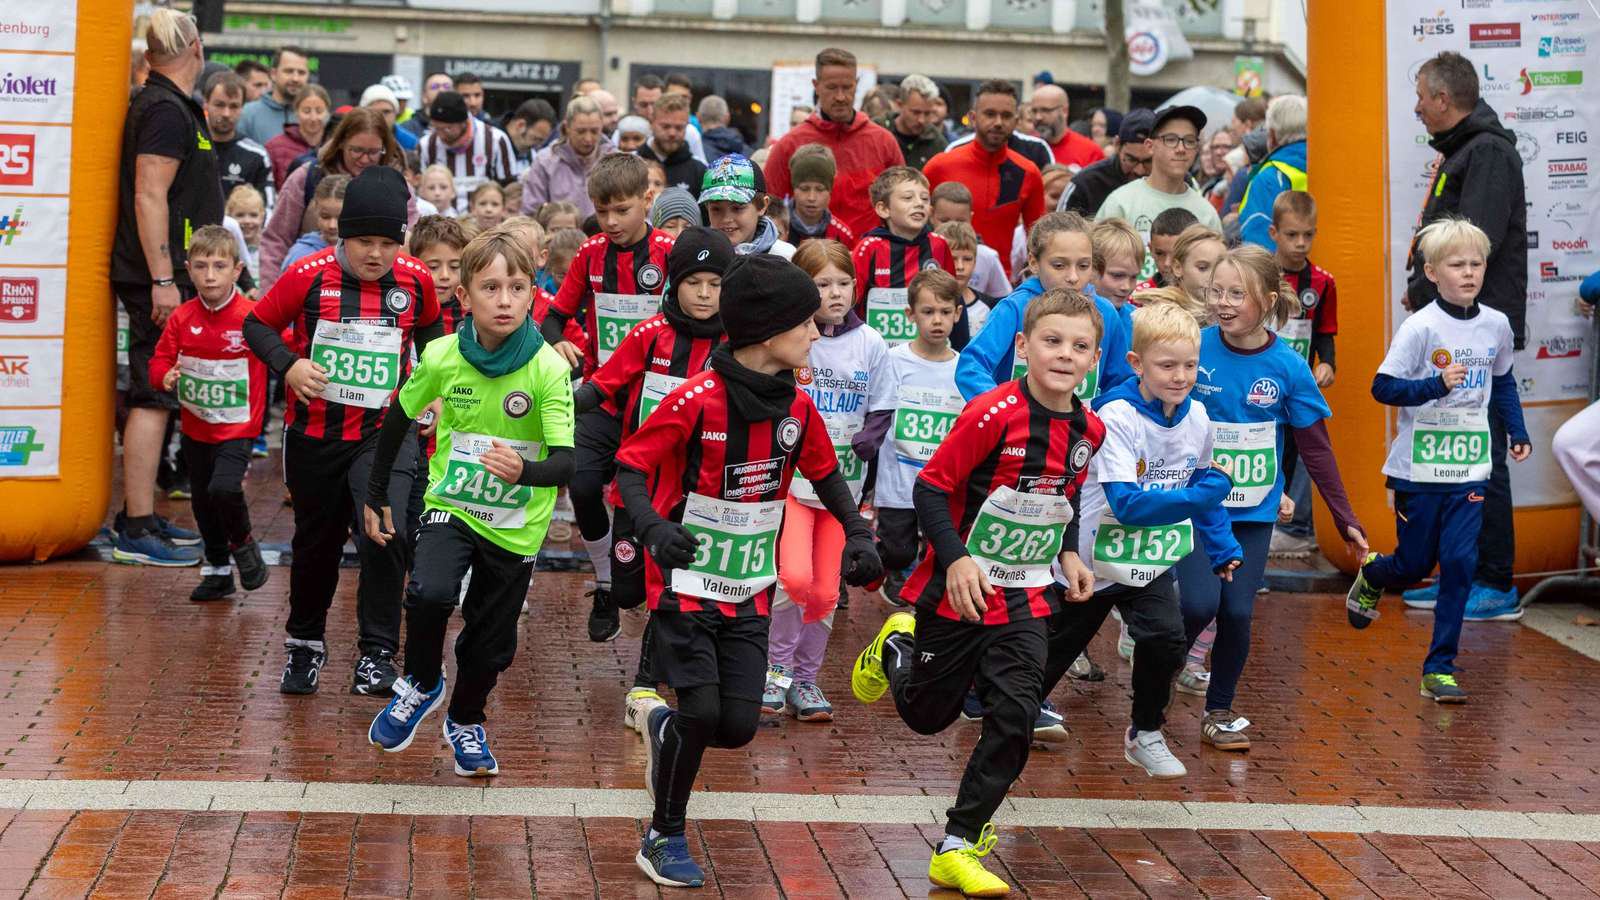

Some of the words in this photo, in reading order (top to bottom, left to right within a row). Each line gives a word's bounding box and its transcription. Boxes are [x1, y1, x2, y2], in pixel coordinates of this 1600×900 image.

[543, 64, 561, 80] 17
[1556, 131, 1588, 144] FEIG
[1547, 162, 1588, 173] STRABAG
[2, 282, 35, 296] RHÖN
[320, 289, 341, 297] JAKO
[876, 312, 918, 337] 335
[1455, 349, 1472, 358] BAD
[321, 350, 389, 385] 3355
[652, 357, 671, 367] JAKO
[812, 368, 833, 379] BAD
[185, 379, 237, 405] 3491
[340, 389, 364, 401] Liam
[453, 387, 473, 395] JAKO
[701, 431, 727, 441] JAKO
[1001, 447, 1026, 456] JAKO
[1421, 434, 1482, 462] 3469
[1216, 453, 1267, 483] 208
[1434, 468, 1470, 478] Leonard
[1225, 491, 1246, 502] otta
[980, 522, 1055, 561] 3262
[1105, 528, 1181, 561] 3152
[694, 532, 768, 574] 3115
[1130, 568, 1157, 581] Paul
[702, 577, 752, 597] Valentin
